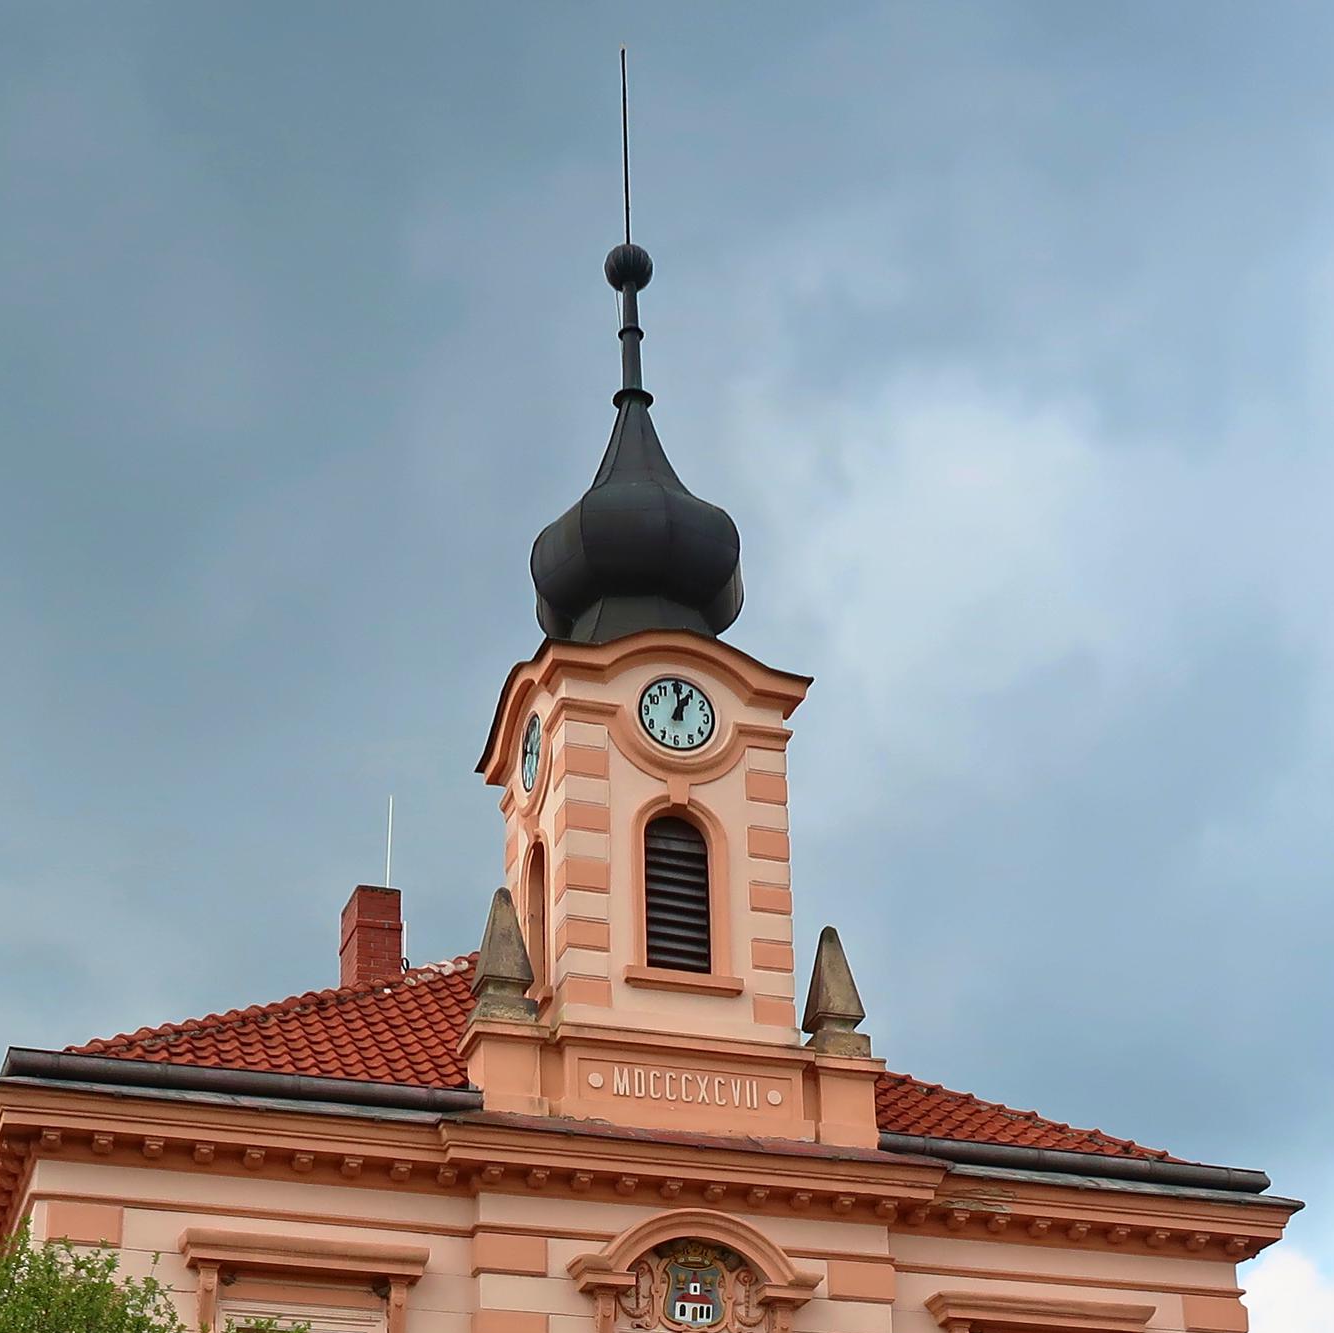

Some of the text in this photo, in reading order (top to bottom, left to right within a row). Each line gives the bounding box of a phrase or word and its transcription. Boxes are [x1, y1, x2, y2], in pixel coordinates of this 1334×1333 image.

[657, 684, 667, 697] 11
[647, 693, 660, 705] 10
[643, 704, 650, 716] 9
[698, 700, 706, 712] 2
[648, 718, 655, 730] 8
[702, 713, 710, 725] 3
[697, 726, 705, 737] 4
[673, 735, 680, 746] 6
[687, 734, 695, 745] 5
[612, 1066, 758, 1109] MDCCCXCVII
